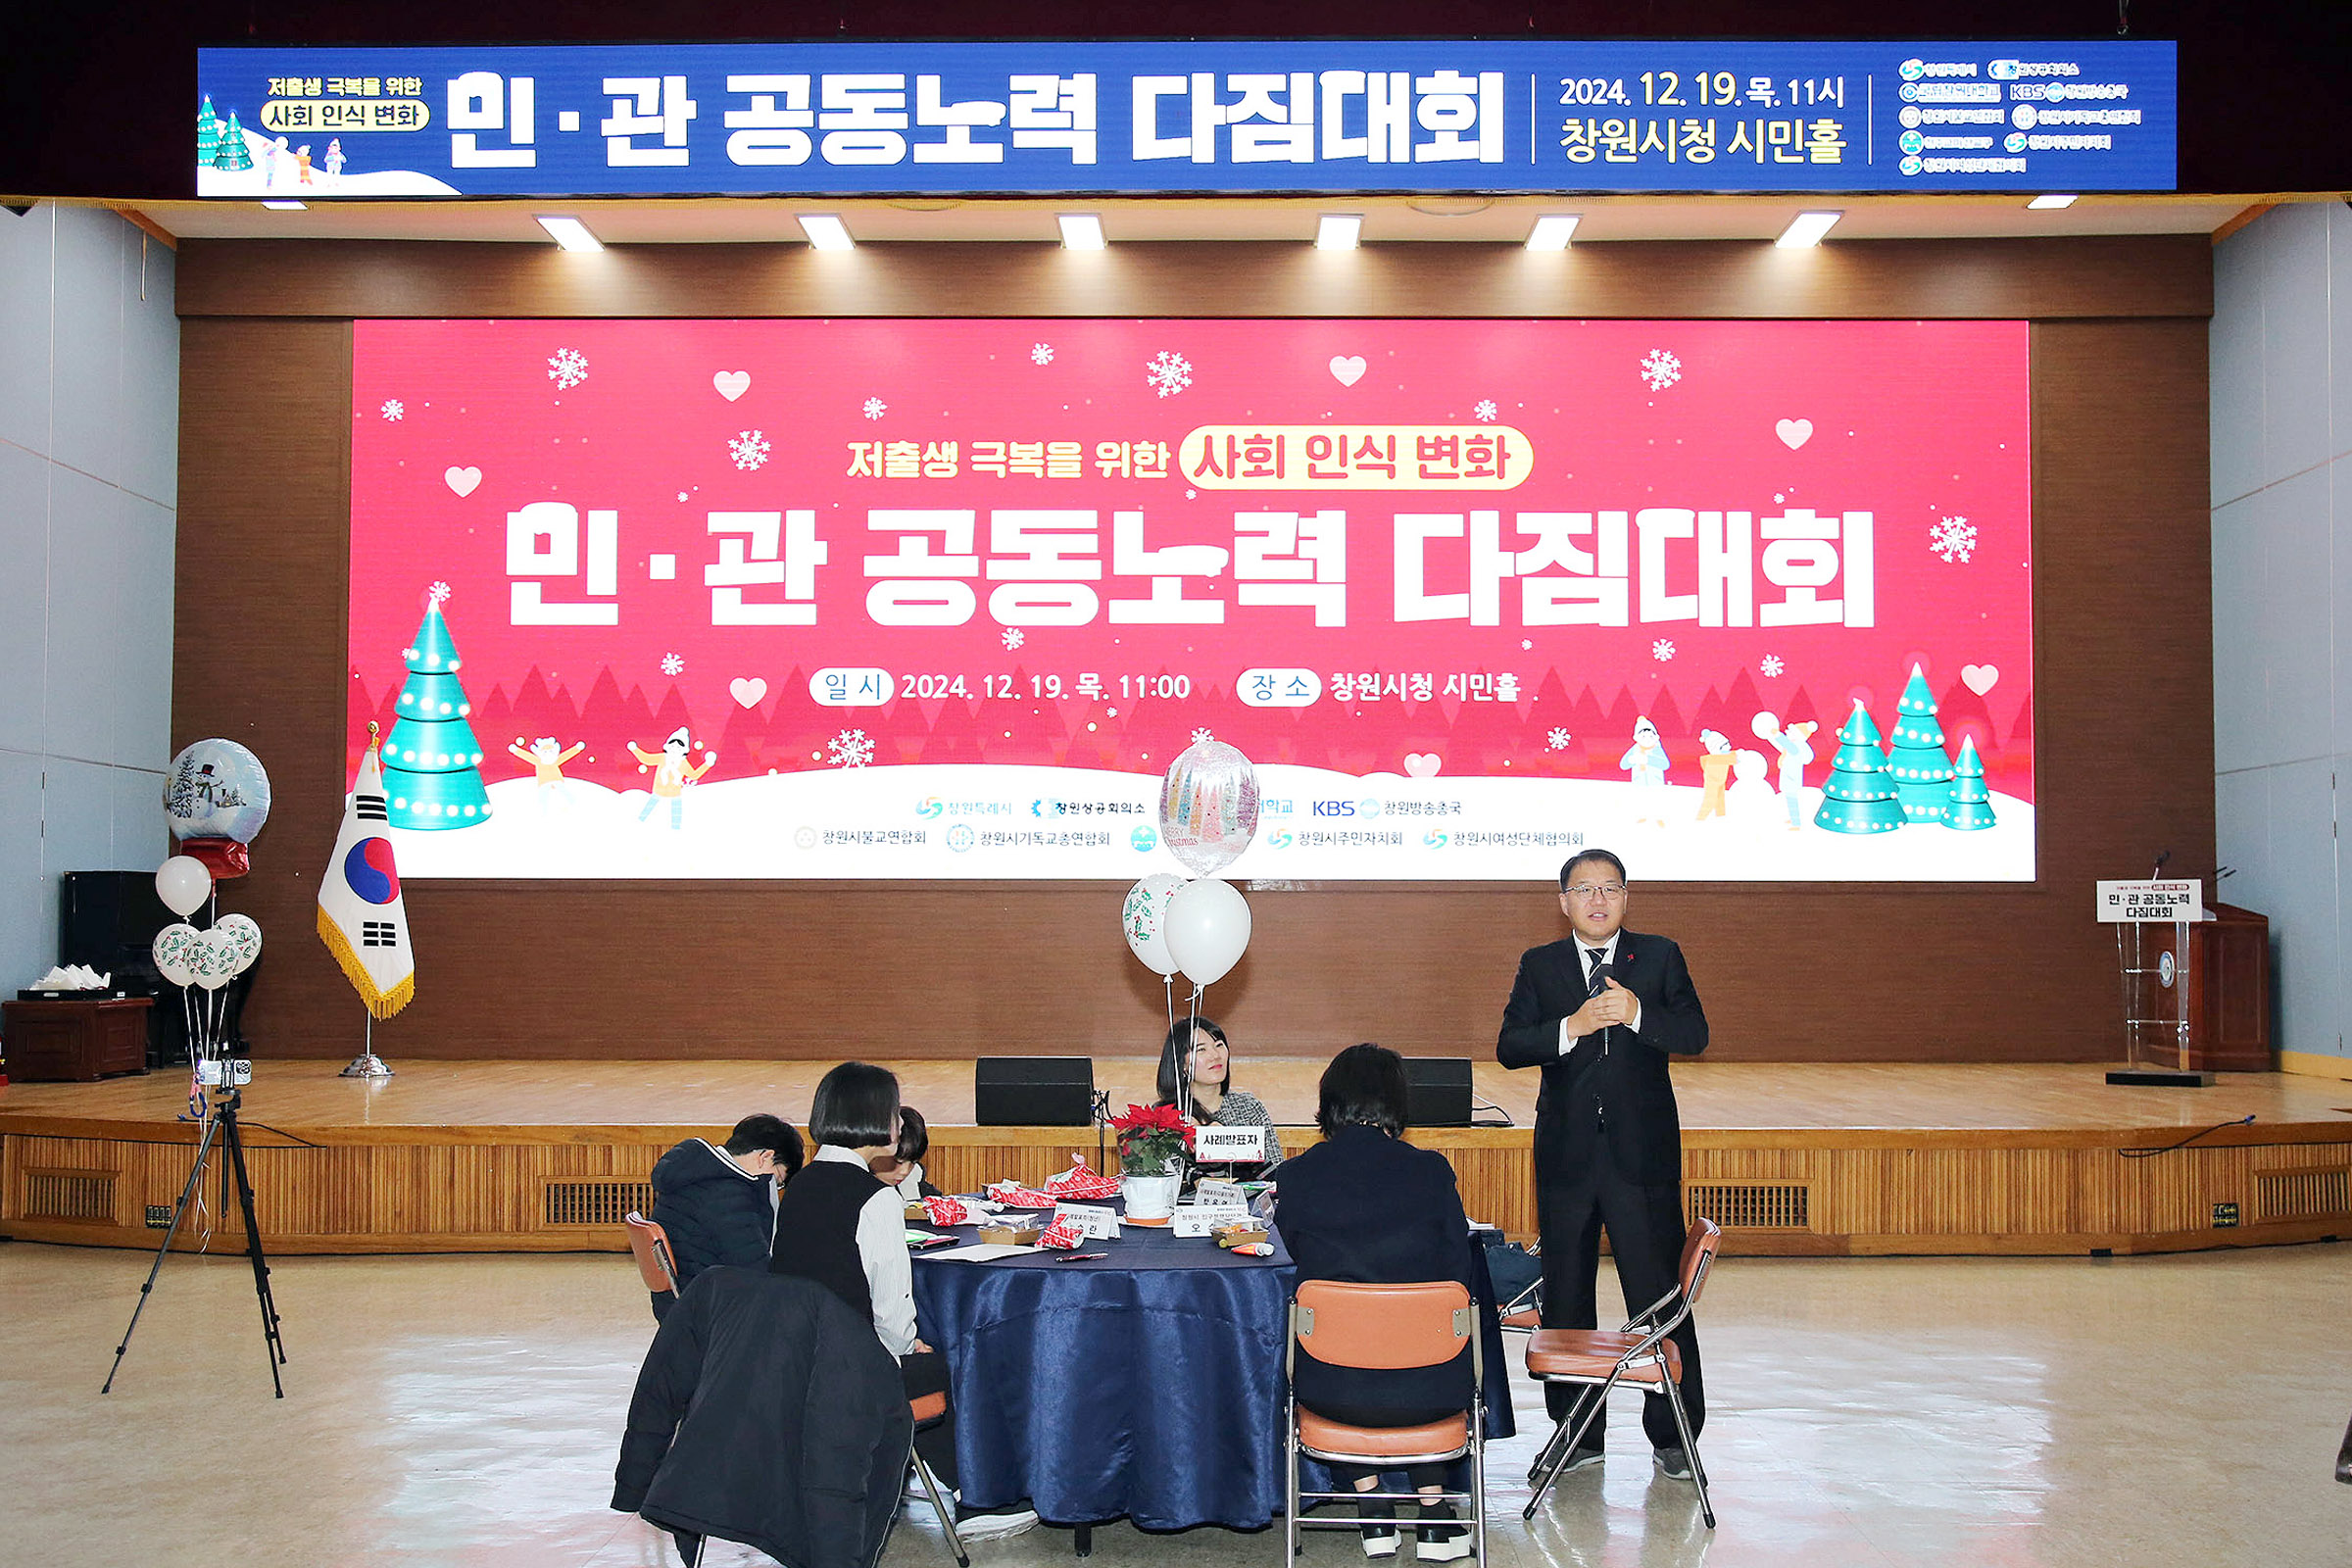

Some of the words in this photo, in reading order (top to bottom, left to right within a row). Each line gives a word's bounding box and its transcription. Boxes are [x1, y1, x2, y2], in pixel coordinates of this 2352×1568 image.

[268, 77, 322, 96] 저출생
[327, 77, 381, 96] 극복을
[385, 76, 423, 96] 위한
[1559, 78, 1632, 106] 2024.
[1640, 72, 1688, 106] 12.
[1788, 75, 1844, 108] 11시
[2011, 85, 2044, 98] KBS
[270, 105, 313, 126] 사회
[322, 105, 366, 126] 인식
[374, 105, 419, 126] 변화
[723, 72, 1098, 167] 공동노력
[1132, 70, 1504, 165] 다짐대회
[1559, 118, 1716, 164] 창원시청
[1727, 118, 1847, 164] 시민홀
[847, 441, 959, 479] 저출생
[970, 441, 1083, 479] 극복을
[1095, 441, 1171, 479] 위한
[1194, 433, 1287, 480] 사회
[1306, 433, 1396, 480] 인식
[1417, 433, 1511, 480] 변화
[862, 509, 1347, 627] 공동노력
[1394, 508, 1874, 627] 다짐대회
[901, 674, 974, 700] 2024.
[983, 674, 1021, 700] 12.
[1030, 674, 1068, 700] 19.
[1075, 672, 1109, 701] 목.
[1119, 674, 1190, 699] 11:00
[1330, 672, 1434, 702] 창원시청
[1442, 672, 1521, 703] 시민홀
[948, 802, 1011, 815] 창원특례시
[1055, 802, 1146, 815] 창원상공회의소
[1312, 800, 1354, 816] KBS
[1384, 800, 1461, 816] 창원방송총국
[822, 829, 926, 845] 창원시불교연합회
[980, 830, 1110, 847] 창원시기독교총연합회
[1298, 830, 1402, 846] 창원시주민자치회
[1453, 830, 1584, 847] 창원시여성단체협의회
[2143, 894, 2189, 905] 공동노력
[2126, 906, 2173, 917] 다짐대회
[1203, 1134, 1257, 1146] 사례발표자
